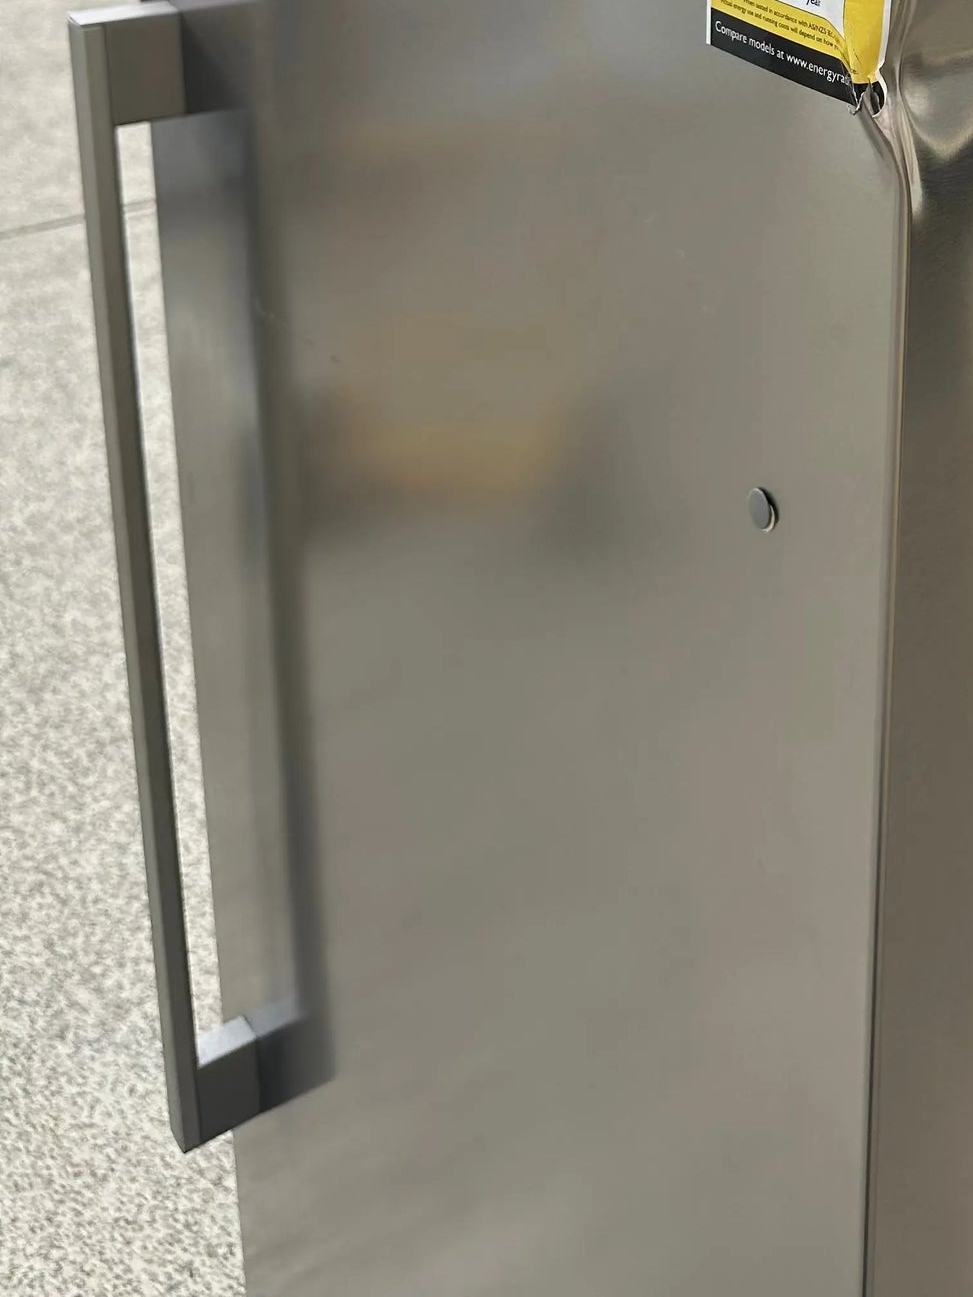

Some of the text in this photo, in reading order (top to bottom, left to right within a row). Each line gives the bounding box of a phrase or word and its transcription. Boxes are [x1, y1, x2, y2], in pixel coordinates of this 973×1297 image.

[715, 20, 748, 44] Compare
[748, 38, 775, 57] models
[776, 48, 785, 61] at
